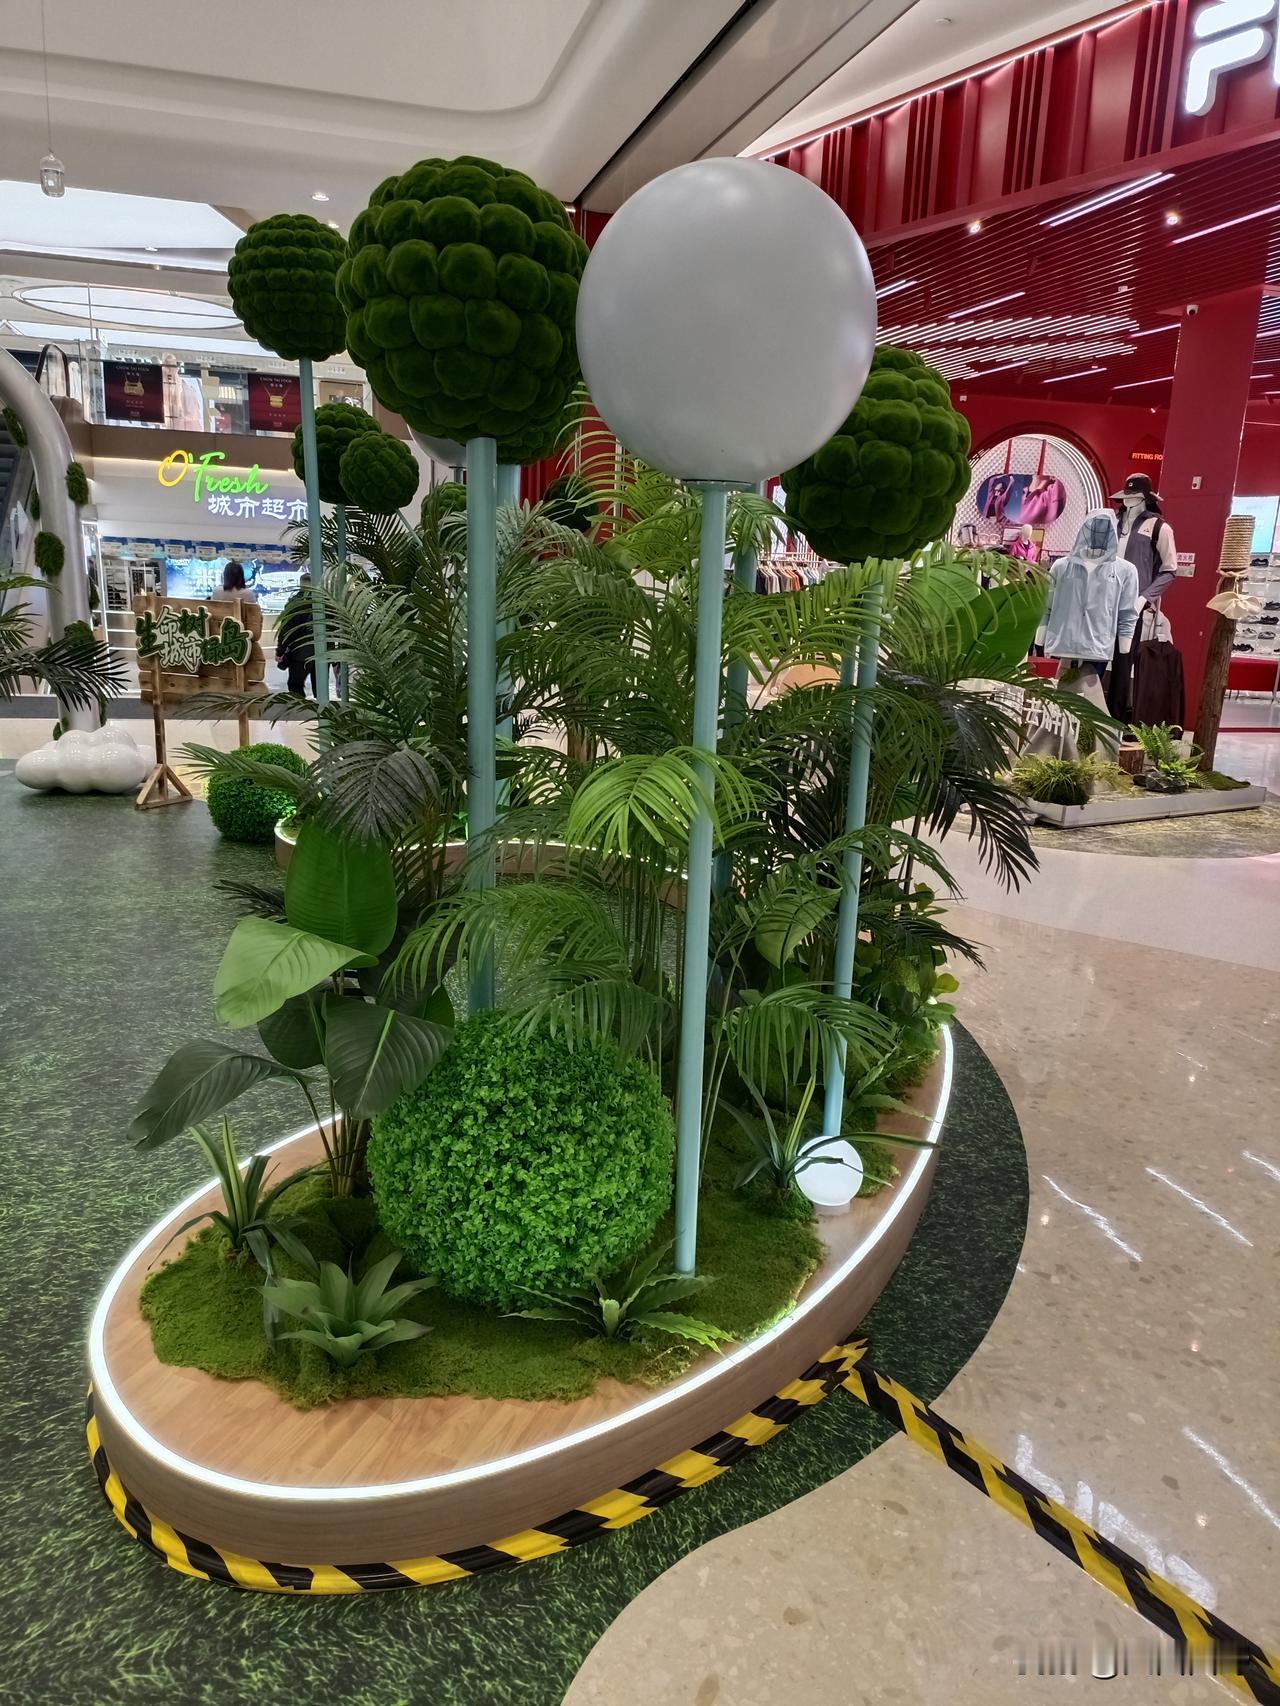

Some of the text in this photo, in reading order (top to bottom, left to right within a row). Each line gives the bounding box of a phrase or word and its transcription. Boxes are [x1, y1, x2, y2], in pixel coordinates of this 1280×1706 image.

[1185, 0, 1280, 117] F
[1131, 452, 1153, 460] FITTING
[207, 494, 309, 521] 城市超市
[135, 605, 209, 658] 生命树
[160, 617, 250, 672] 城市绿岛
